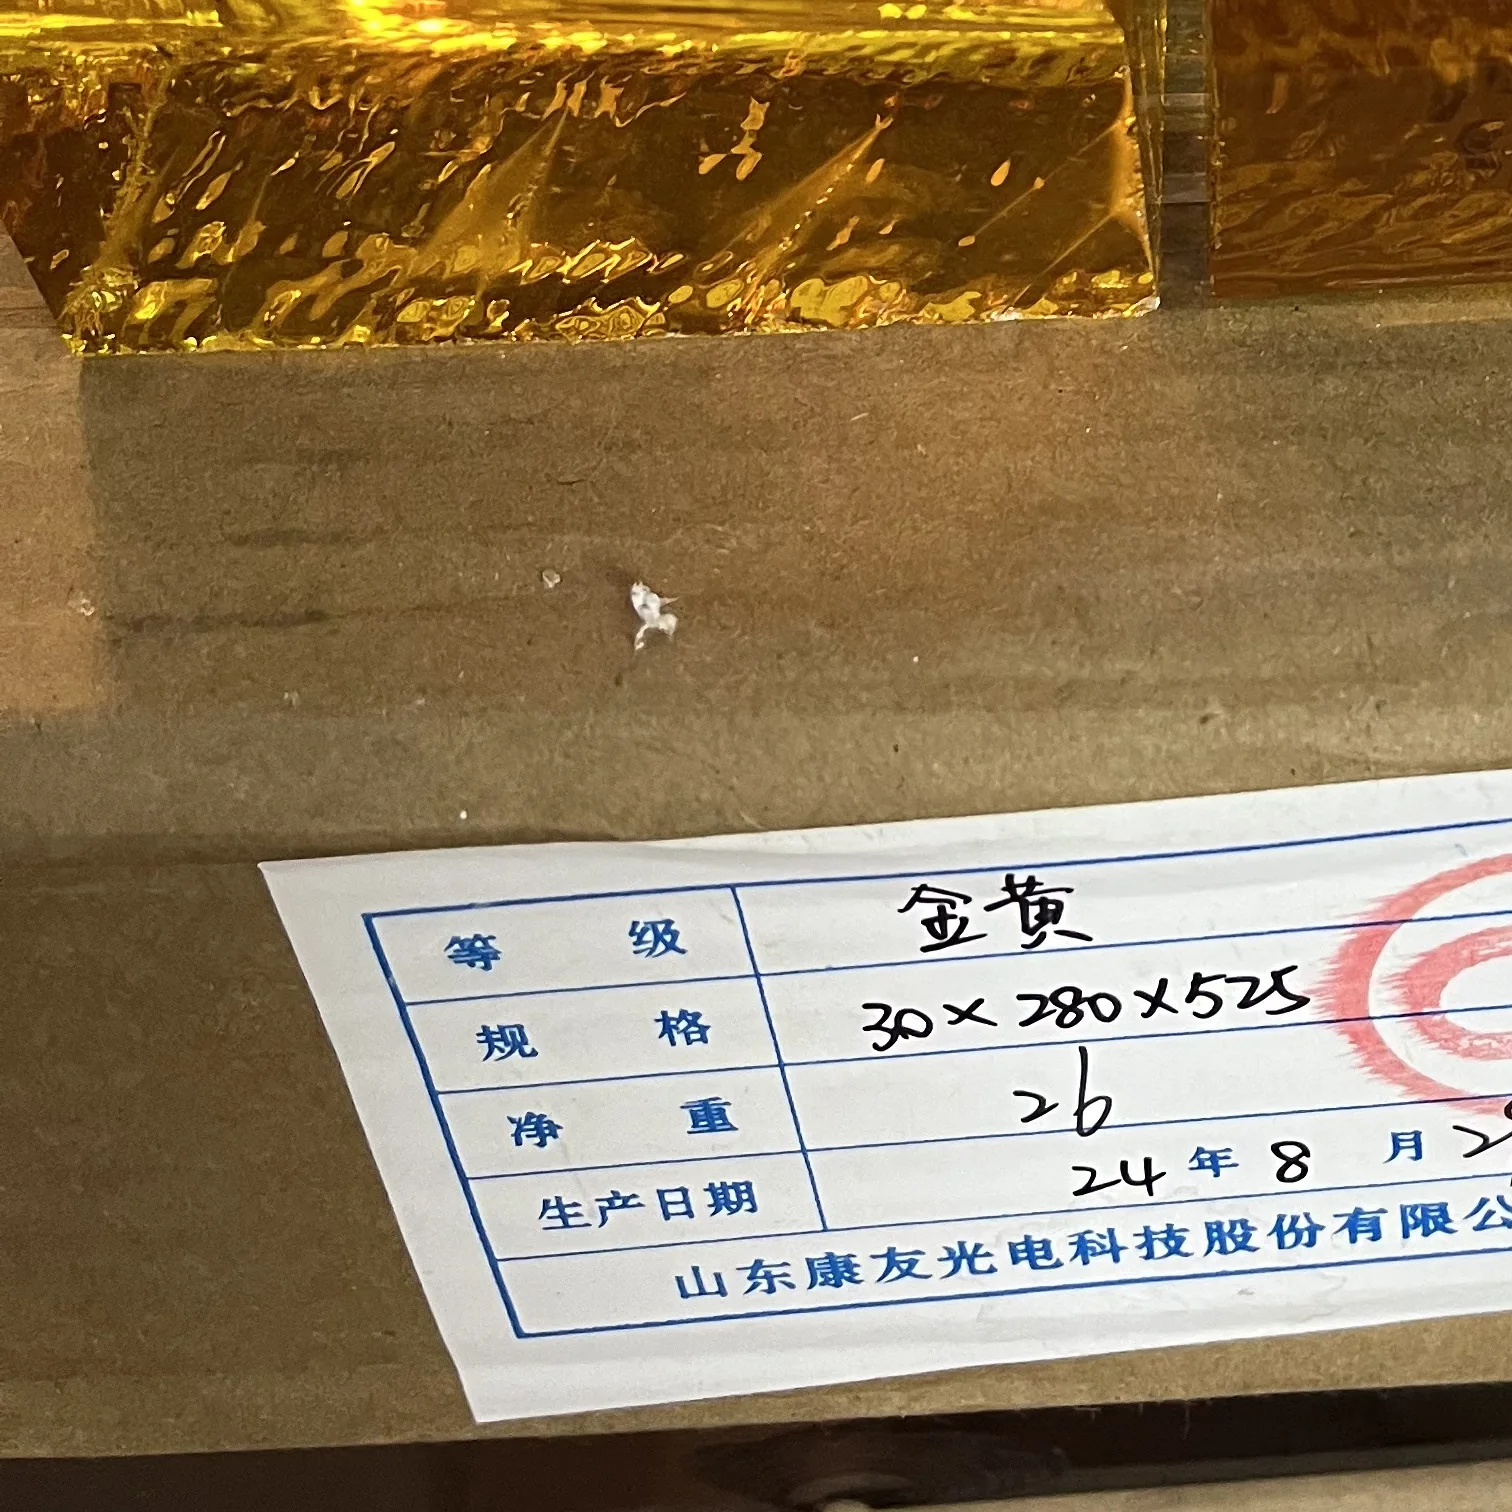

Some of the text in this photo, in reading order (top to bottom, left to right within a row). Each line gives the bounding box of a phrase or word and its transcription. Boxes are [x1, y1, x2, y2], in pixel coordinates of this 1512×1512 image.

[896, 872, 1094, 953] 金黄
[1012, 1045, 1113, 1137] 26
[537, 1179, 759, 1231] 生产日期
